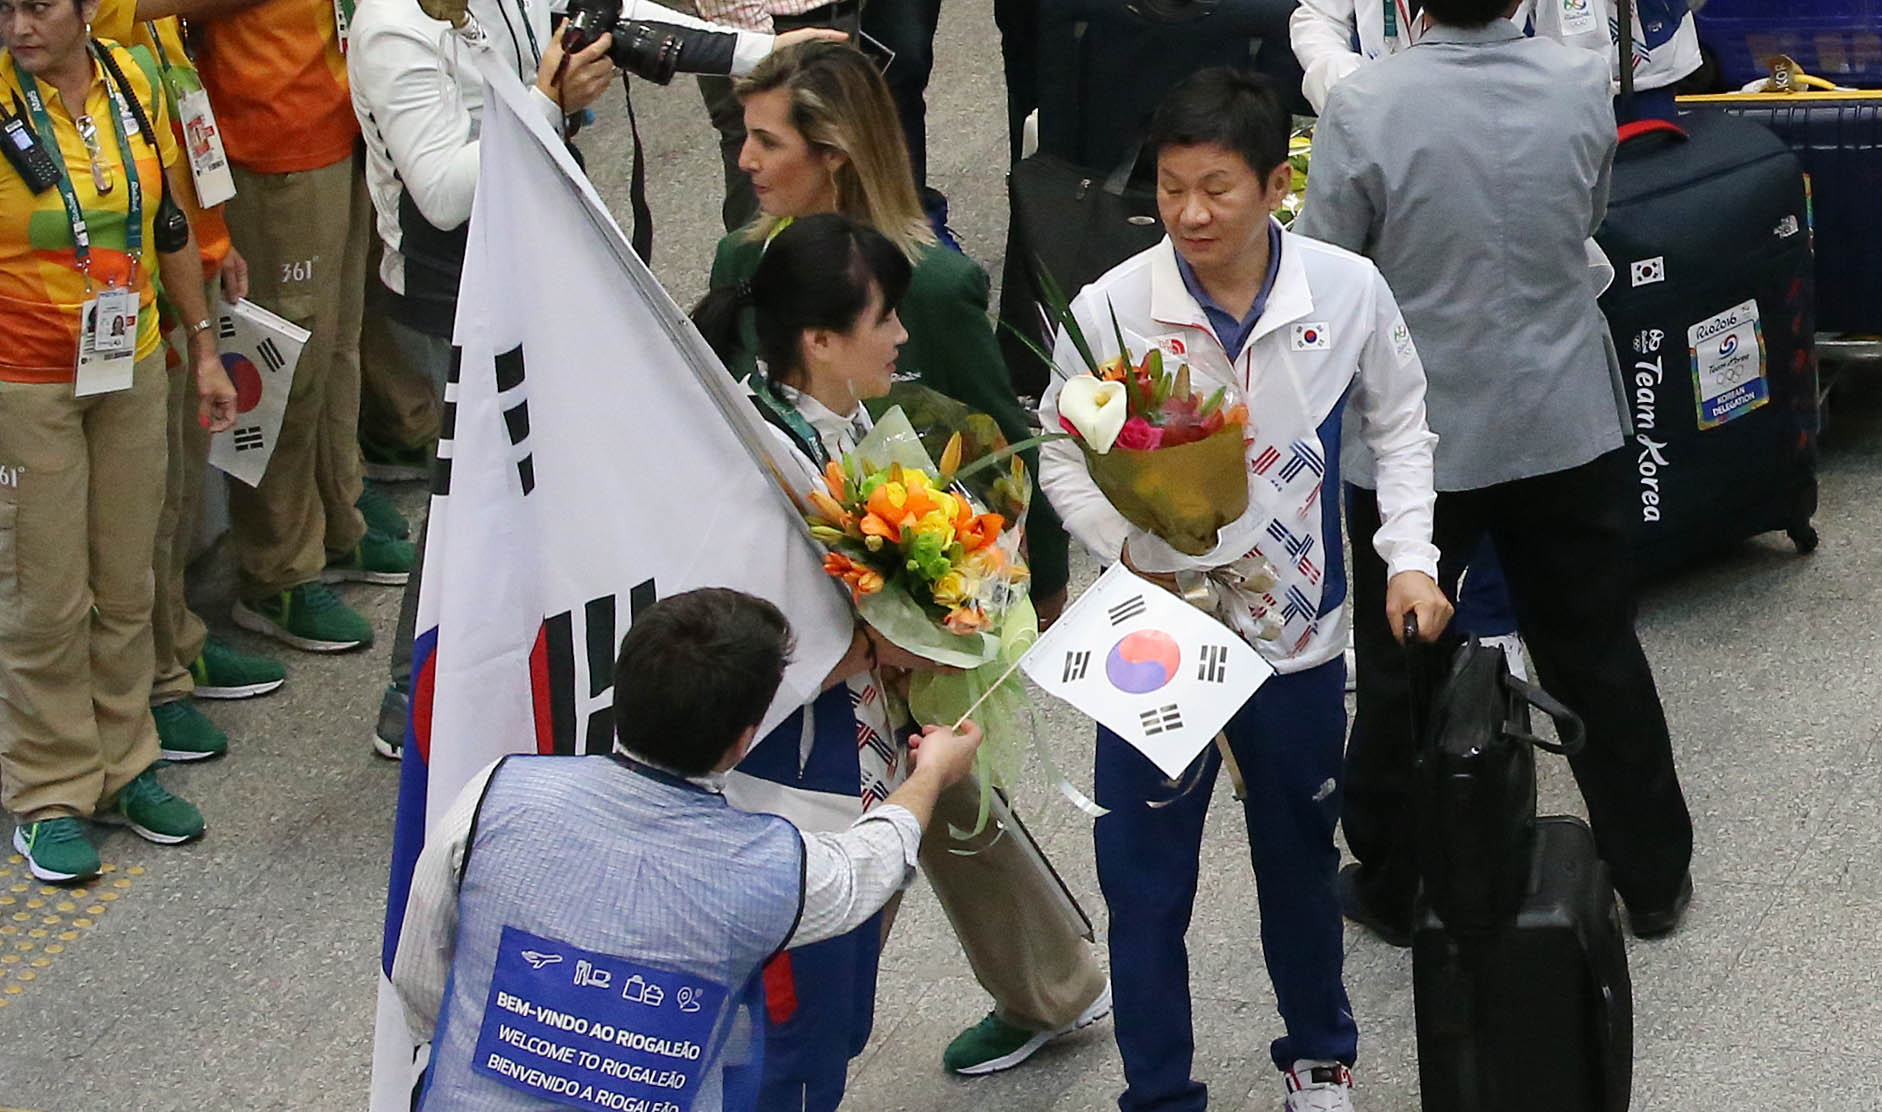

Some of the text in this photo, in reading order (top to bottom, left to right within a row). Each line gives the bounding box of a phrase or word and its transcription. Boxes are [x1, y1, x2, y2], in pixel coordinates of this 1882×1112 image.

[1697, 312, 1738, 341] Rio2016
[1712, 392, 1756, 417] DELEGATION
[1717, 386, 1746, 406] KOREAN
[1635, 355, 1670, 522] Team Korea
[497, 991, 701, 1060] BEM-VINDO AO RIOGALEÃO
[487, 1053, 580, 1097] BIENVENIDO
[580, 1086, 595, 1102] A
[499, 1024, 687, 1090] WELCOME TO RIOGALEÃO
